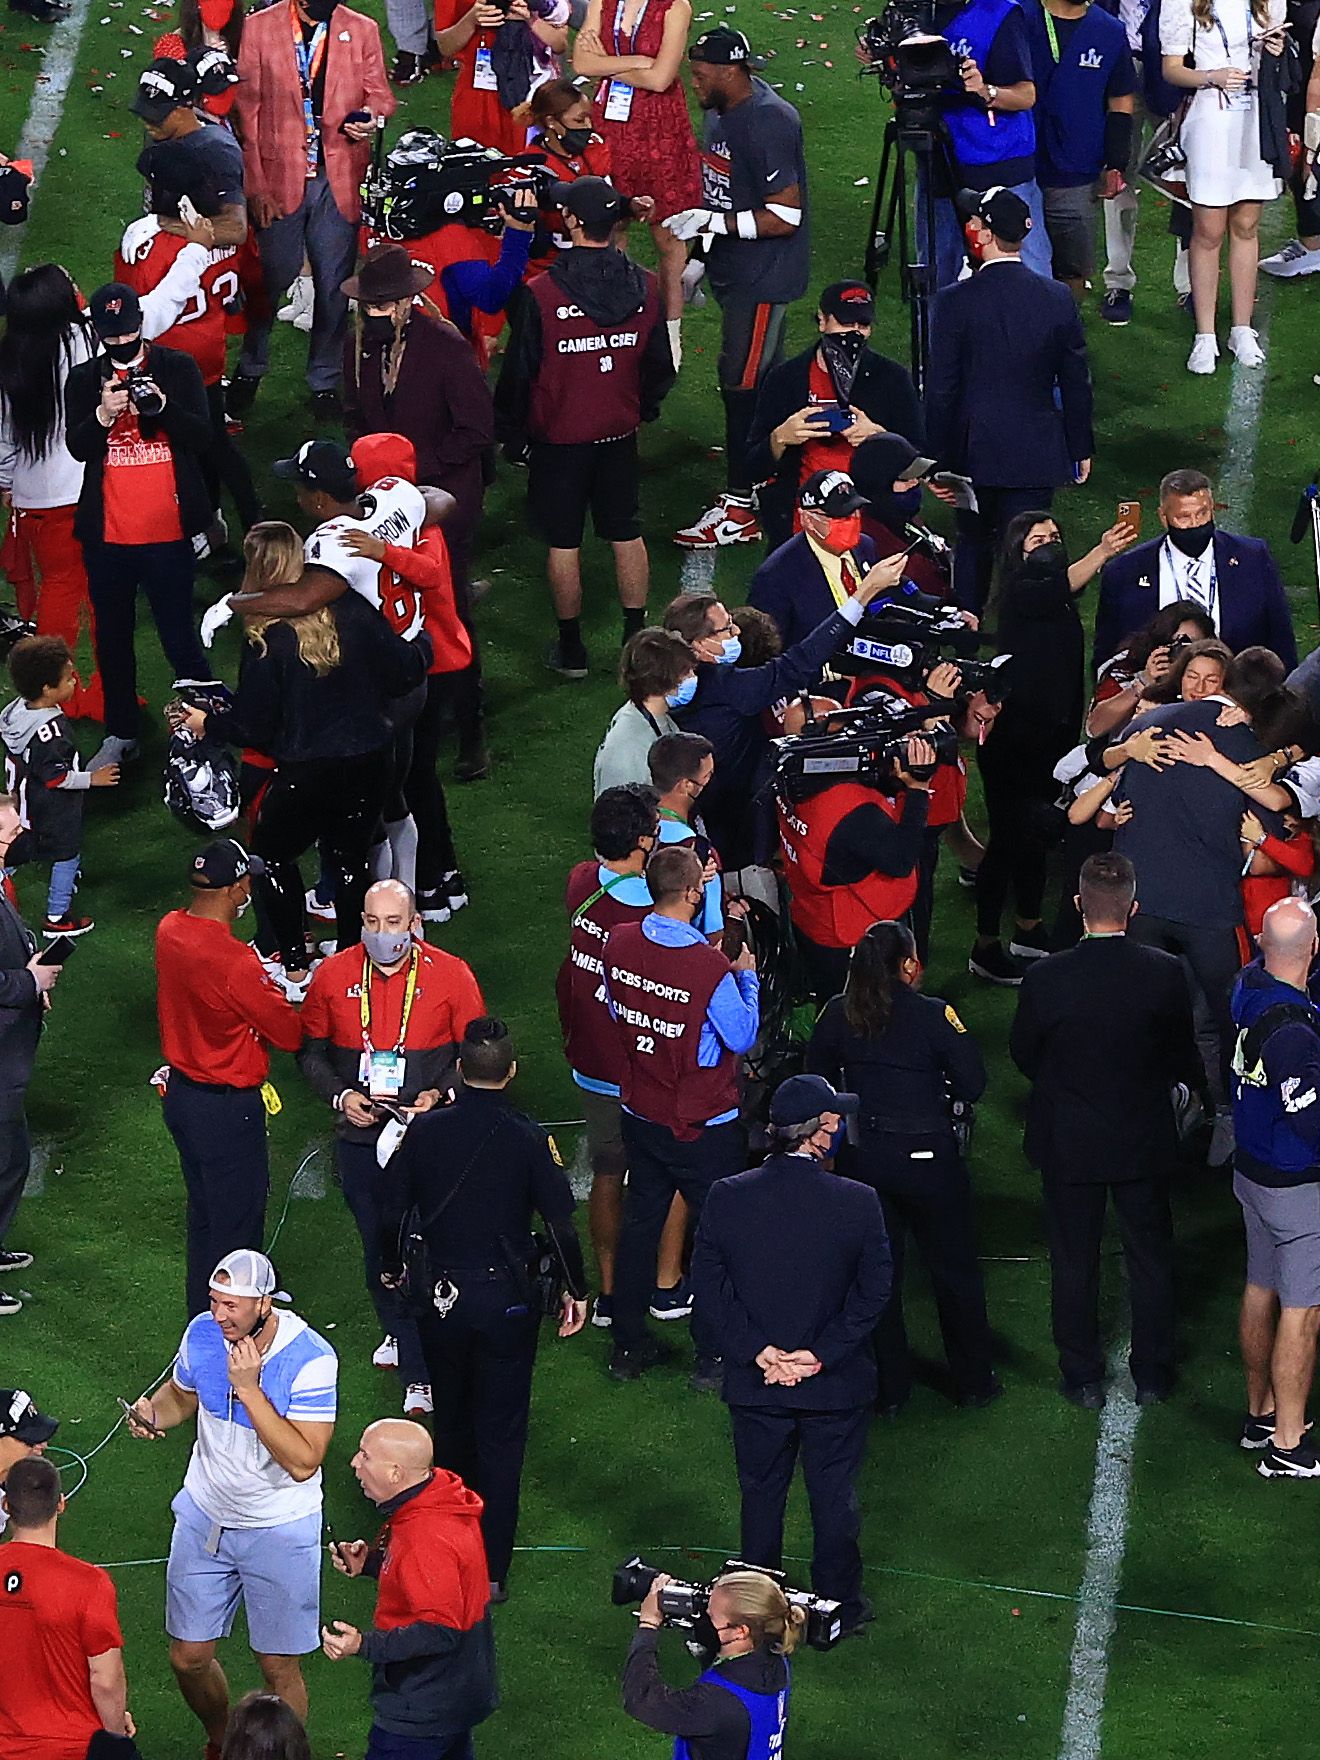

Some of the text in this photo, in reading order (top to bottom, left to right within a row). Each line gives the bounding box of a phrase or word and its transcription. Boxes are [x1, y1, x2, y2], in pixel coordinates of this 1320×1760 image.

[558, 334, 608, 353] CAMERA
[871, 645, 892, 661] NFL
[37, 720, 62, 743] 81
[618, 969, 692, 1004] CBS SPORTS
[652, 1017, 686, 1039] CREW
[636, 1035, 655, 1055] 22
